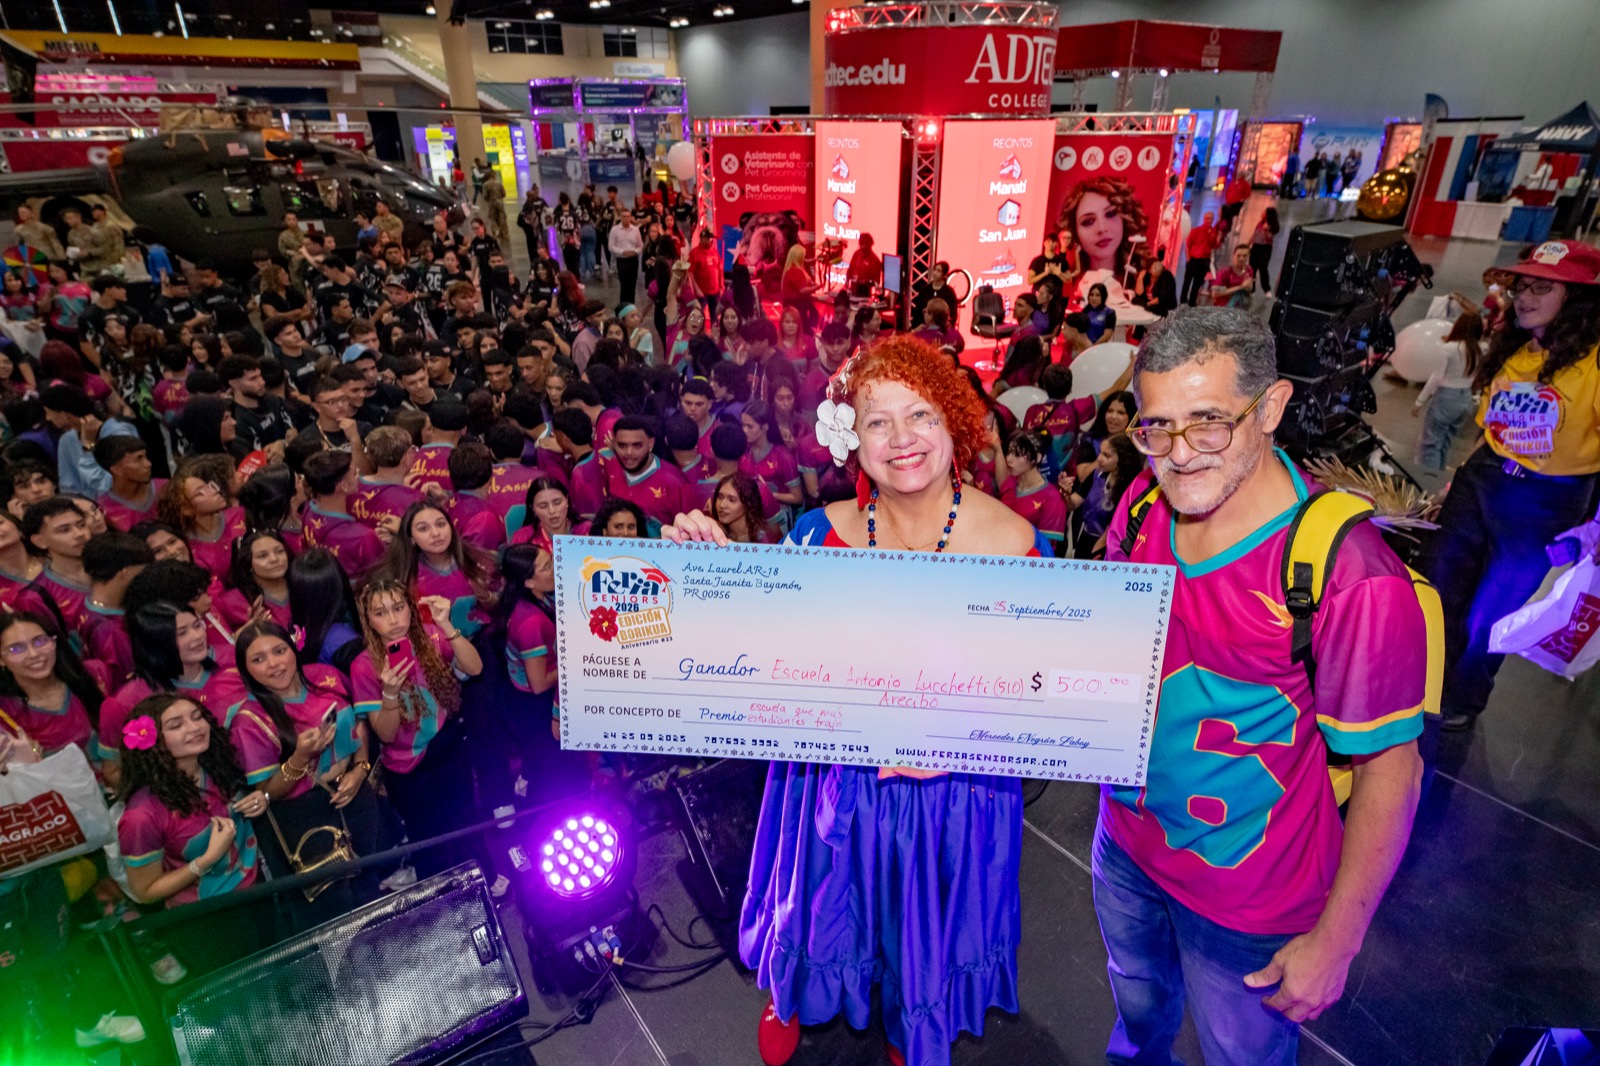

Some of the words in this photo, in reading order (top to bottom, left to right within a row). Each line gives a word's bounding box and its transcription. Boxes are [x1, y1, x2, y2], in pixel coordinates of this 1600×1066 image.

[1535, 125, 1594, 141] NAVY
[993, 137, 1033, 149] RECINTOS
[744, 151, 787, 160] Asistente
[789, 151, 801, 160] de
[744, 160, 795, 169] Veterinario
[796, 161, 813, 169] con
[744, 169, 760, 177] Pet
[762, 170, 807, 179] Grooming
[745, 184, 760, 193] Pet
[762, 184, 807, 194] Grooming
[989, 178, 1028, 196] Manatí
[745, 192, 793, 201] Profesional
[560, 216, 574, 230] 26
[823, 223, 837, 237] San
[838, 226, 861, 240] Juan
[979, 229, 1002, 243] San
[1003, 227, 1027, 241] Juan
[682, 562, 704, 573] Ave.
[707, 561, 742, 575] Laurel
[743, 565, 779, 578] AR-18
[591, 569, 660, 596] Feria
[683, 575, 712, 586] Santa
[712, 576, 753, 588] Juanita
[1124, 581, 1153, 593] 2025
[591, 593, 659, 605] SENIORS
[683, 588, 705, 601] PR
[702, 590, 731, 600] 00956
[615, 602, 640, 613] 2026
[967, 604, 990, 612] FECHA
[618, 609, 663, 628] EDICIÓN
[619, 622, 668, 641] BORIKUA
[621, 638, 659, 650] Aniversario
[582, 653, 631, 667] PÁGUESE
[633, 657, 642, 667] A
[583, 667, 630, 679] NOMBRE
[633, 670, 647, 680] DE
[678, 653, 761, 681] Ganador
[771, 659, 831, 683] Escuela
[845, 665, 901, 688] Antonio
[1030, 671, 1042, 692] $
[878, 690, 939, 708] Arecibo
[584, 705, 605, 715] POR
[608, 706, 665, 717] CONCEPTO
[667, 708, 682, 719] DE
[699, 707, 747, 722] Premio
[795, 705, 814, 718] que
[603, 731, 617, 739] 24
[622, 732, 635, 740] 25
[658, 734, 686, 742] 2025
[1058, 735, 1090, 748] Laboy
[895, 747, 1067, 767] WWW.FERIASENIORSPR.COM
